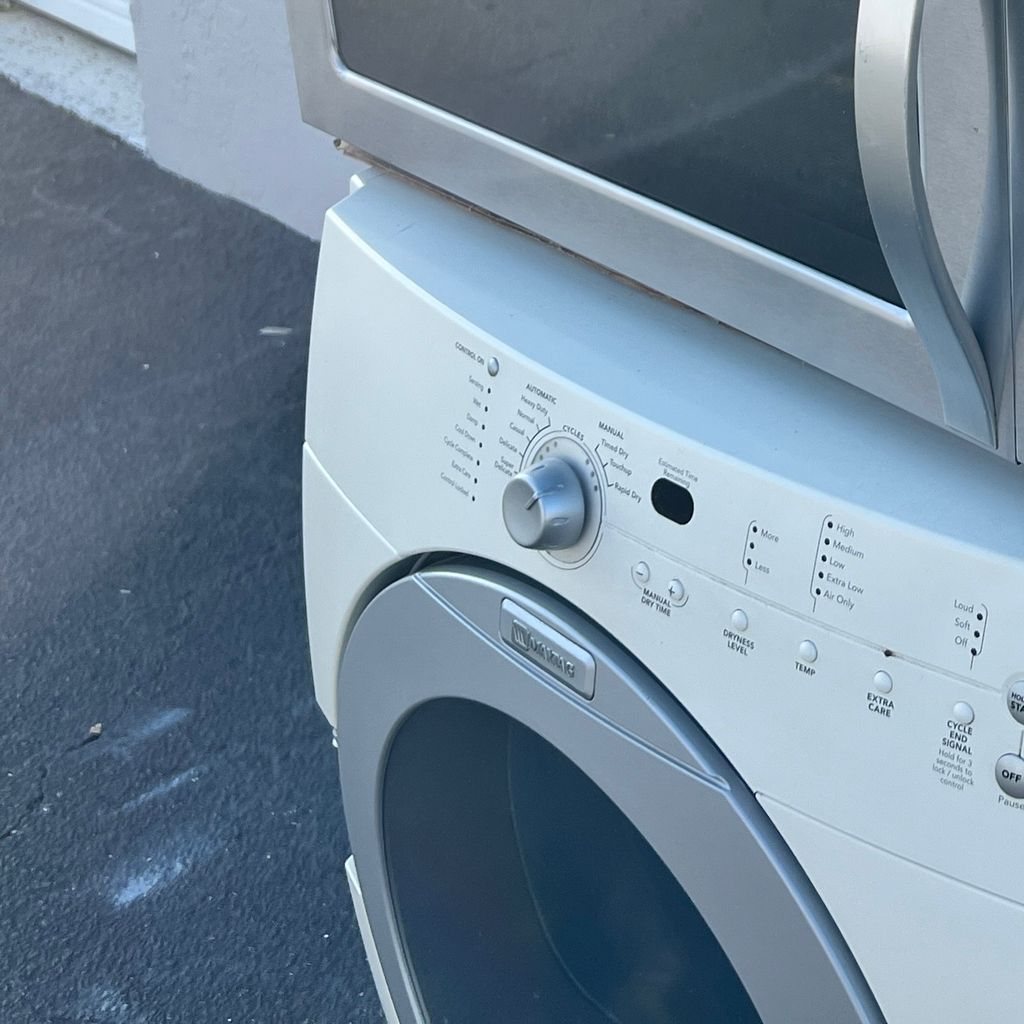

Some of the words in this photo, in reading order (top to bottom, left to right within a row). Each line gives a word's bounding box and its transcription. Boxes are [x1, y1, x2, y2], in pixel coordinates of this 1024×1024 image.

[526, 384, 557, 405] AUTOMATIC
[521, 394, 536, 410] Heavy
[536, 402, 548, 416] Duty
[517, 409, 535, 424] Normal
[562, 425, 584, 441] CYCLES
[598, 421, 624, 440] MANUAL
[601, 438, 618, 452] Timed
[619, 447, 629, 460] Dry
[614, 482, 631, 496] Rapid
[631, 490, 642, 504] Dry
[761, 528, 779, 543] More
[836, 523, 855, 537] High
[832, 539, 864, 559] Medium
[755, 561, 771, 575] Less
[829, 556, 846, 570] Low
[826, 572, 846, 588] Extra
[847, 581, 864, 595] Low
[642, 587, 672, 608] MANUAL
[823, 589, 835, 601] Air
[836, 594, 855, 611] Only
[641, 596, 655, 610] DRY
[654, 601, 671, 617] TIME
[954, 599, 975, 614] Loud
[954, 617, 971, 631] Soft
[723, 628, 755, 650] DRYNESS
[954, 635, 968, 648] Off
[727, 641, 748, 657] LEVEL
[795, 661, 816, 677] TEMP
[866, 692, 895, 710] EXTRA
[868, 702, 892, 718] CARE
[947, 720, 973, 736] CYCLE
[949, 730, 968, 743] END
[942, 737, 972, 755] SIGNAL
[1001, 769, 1022, 783] OFF
